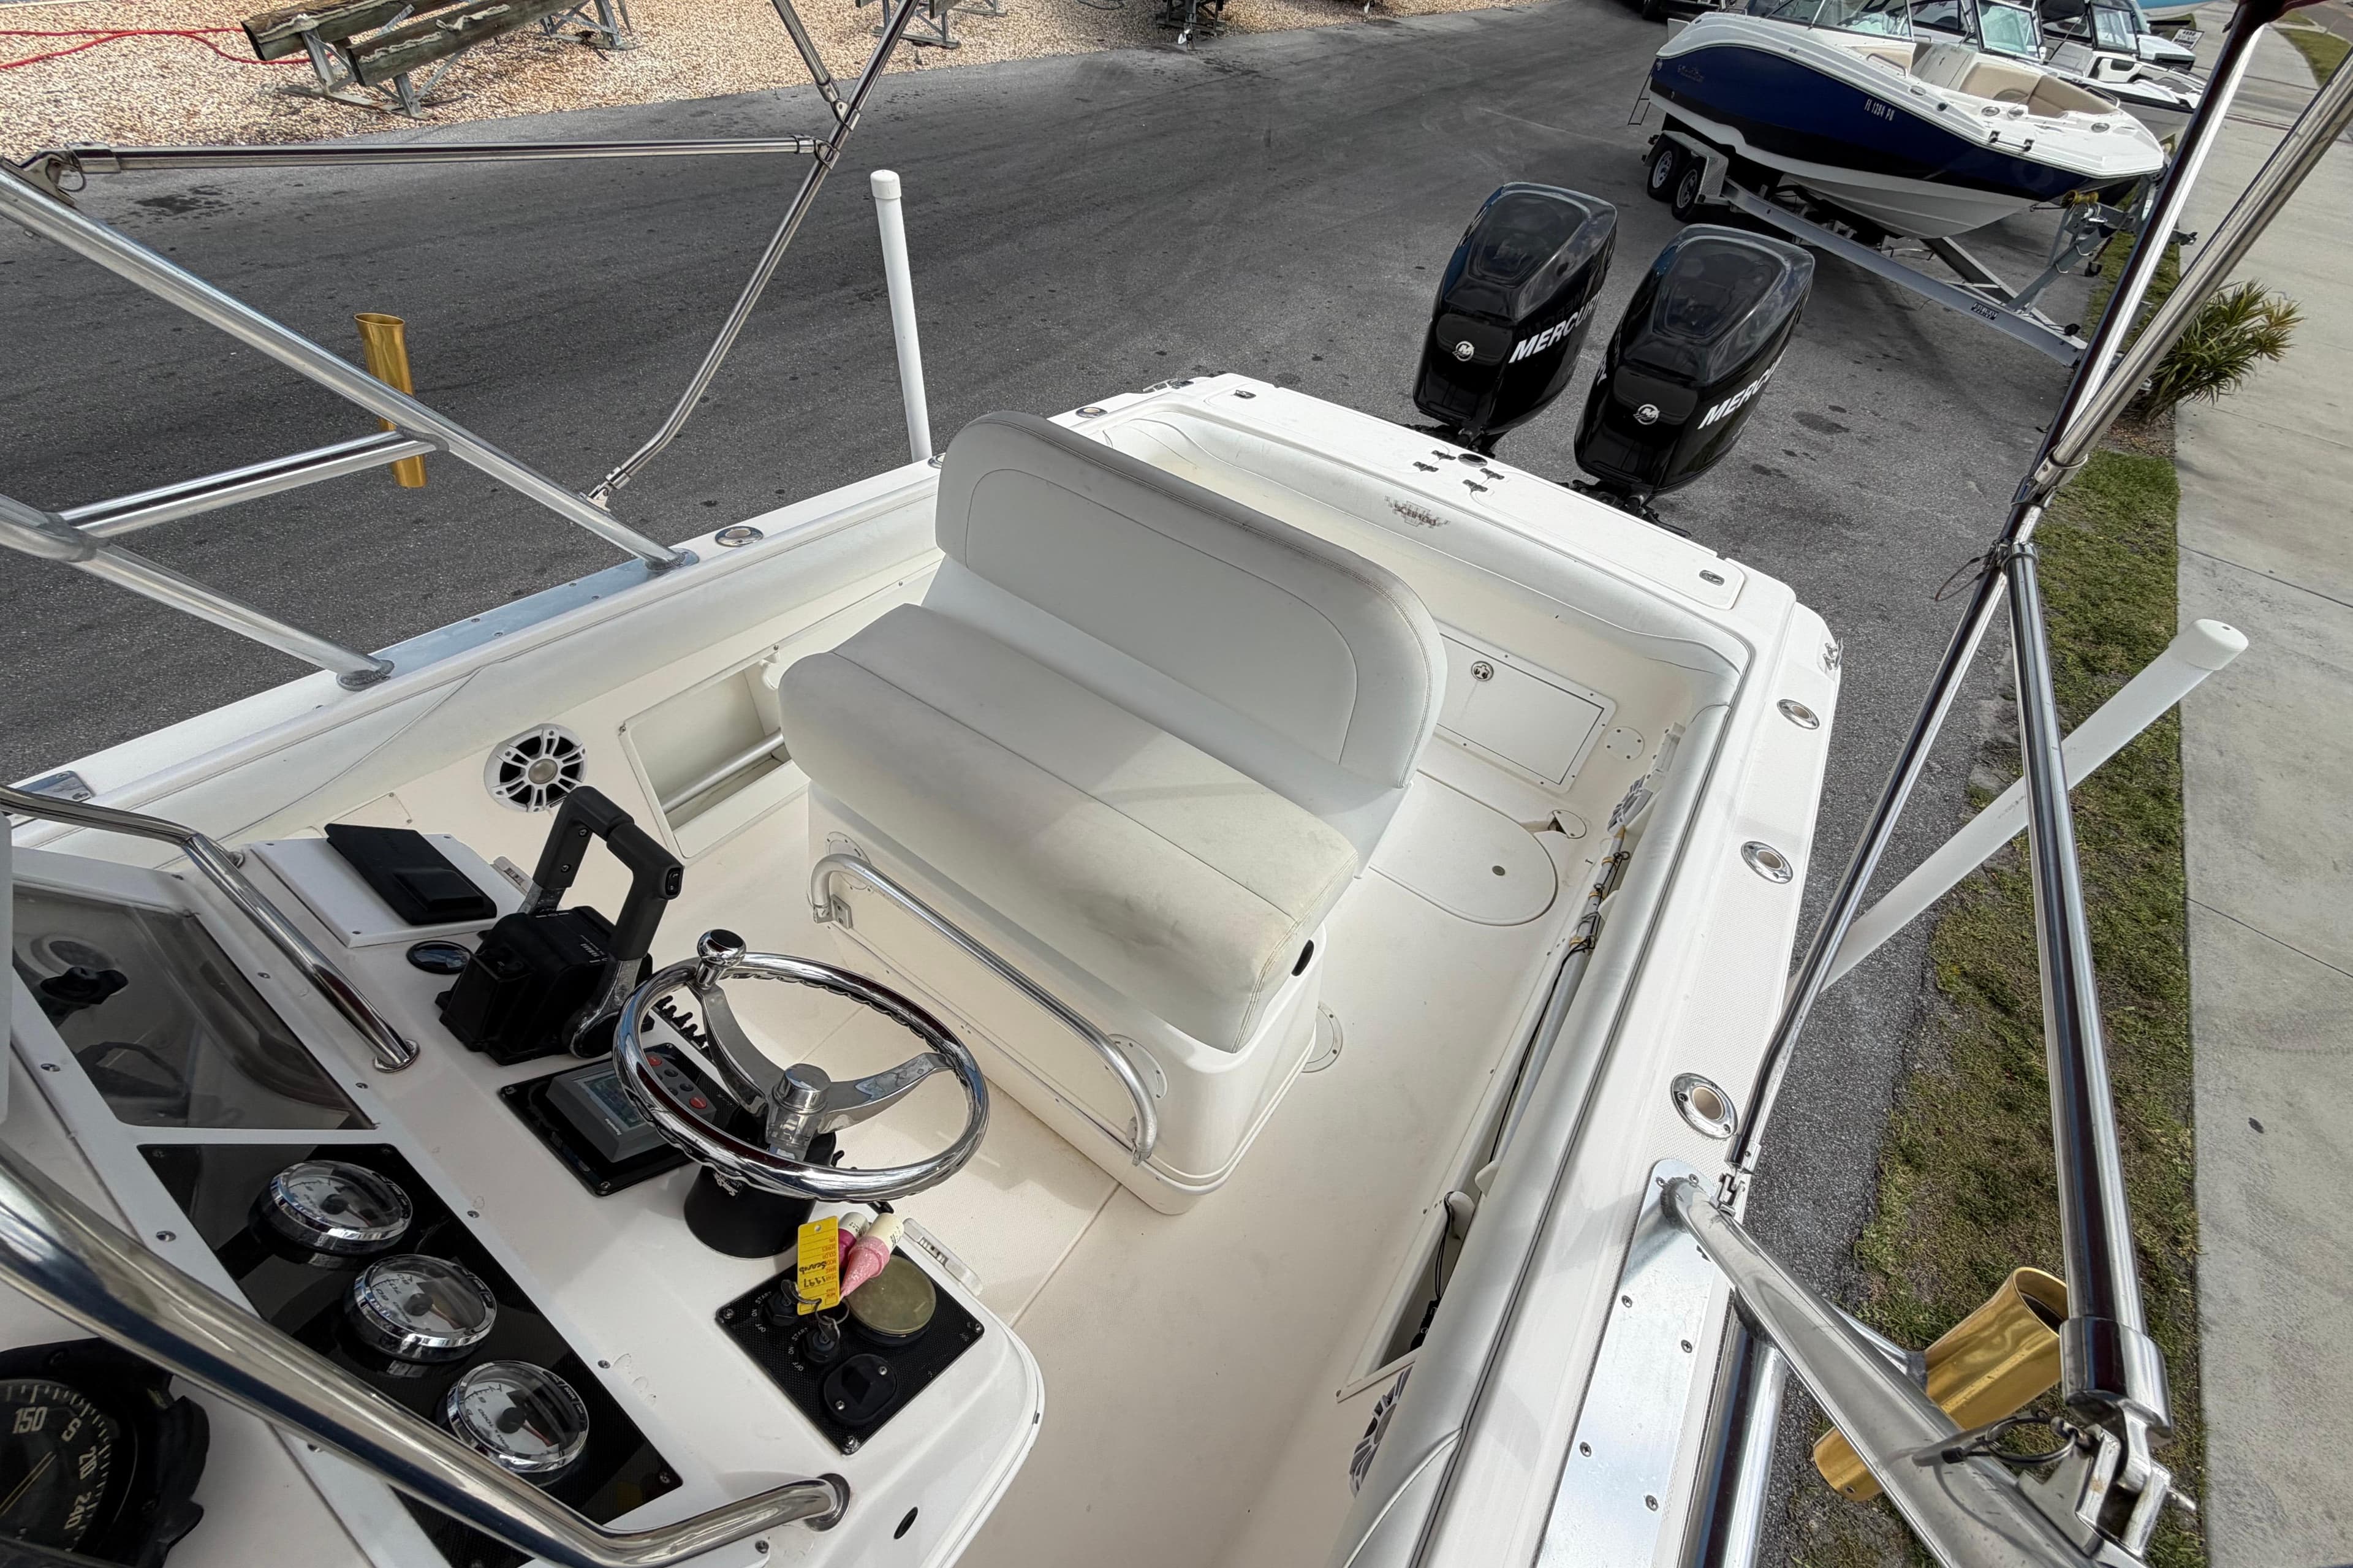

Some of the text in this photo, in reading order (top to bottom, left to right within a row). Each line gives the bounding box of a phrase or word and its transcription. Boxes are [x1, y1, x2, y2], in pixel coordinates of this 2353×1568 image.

[755, 1291, 772, 1305] START
[755, 1324, 766, 1333] OFF
[791, 1327, 808, 1341] START
[792, 1362, 804, 1371] OFF
[12, 1406, 48, 1434] 150
[61, 1417, 82, 1441] S
[63, 1491, 92, 1529] 240
